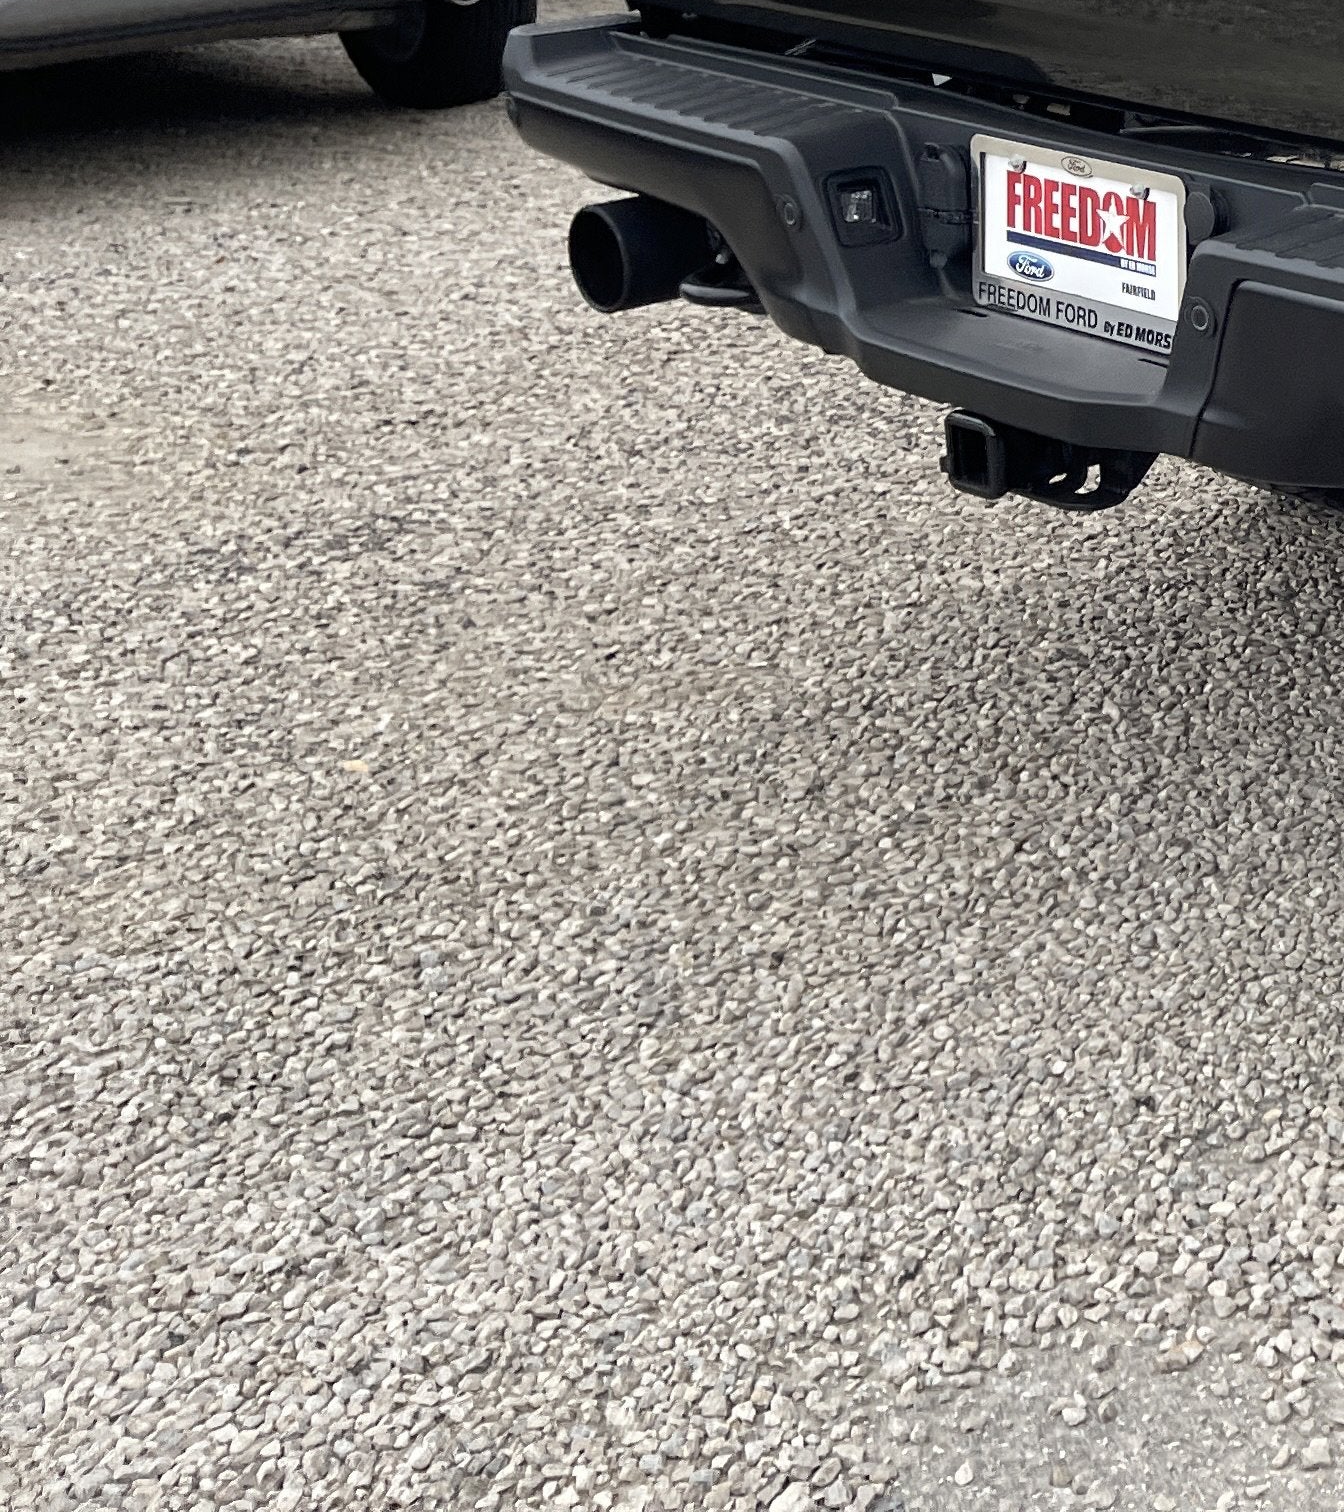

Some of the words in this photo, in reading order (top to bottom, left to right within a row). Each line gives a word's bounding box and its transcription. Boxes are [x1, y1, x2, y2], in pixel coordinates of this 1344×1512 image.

[1006, 170, 1157, 262] FREEDOM
[978, 282, 1051, 317] FREEDOM
[1056, 301, 1098, 329] FORD
[1117, 322, 1133, 338] ED
[1135, 326, 1172, 349] MORS
[1122, 282, 1156, 301] FAIRFIELD
